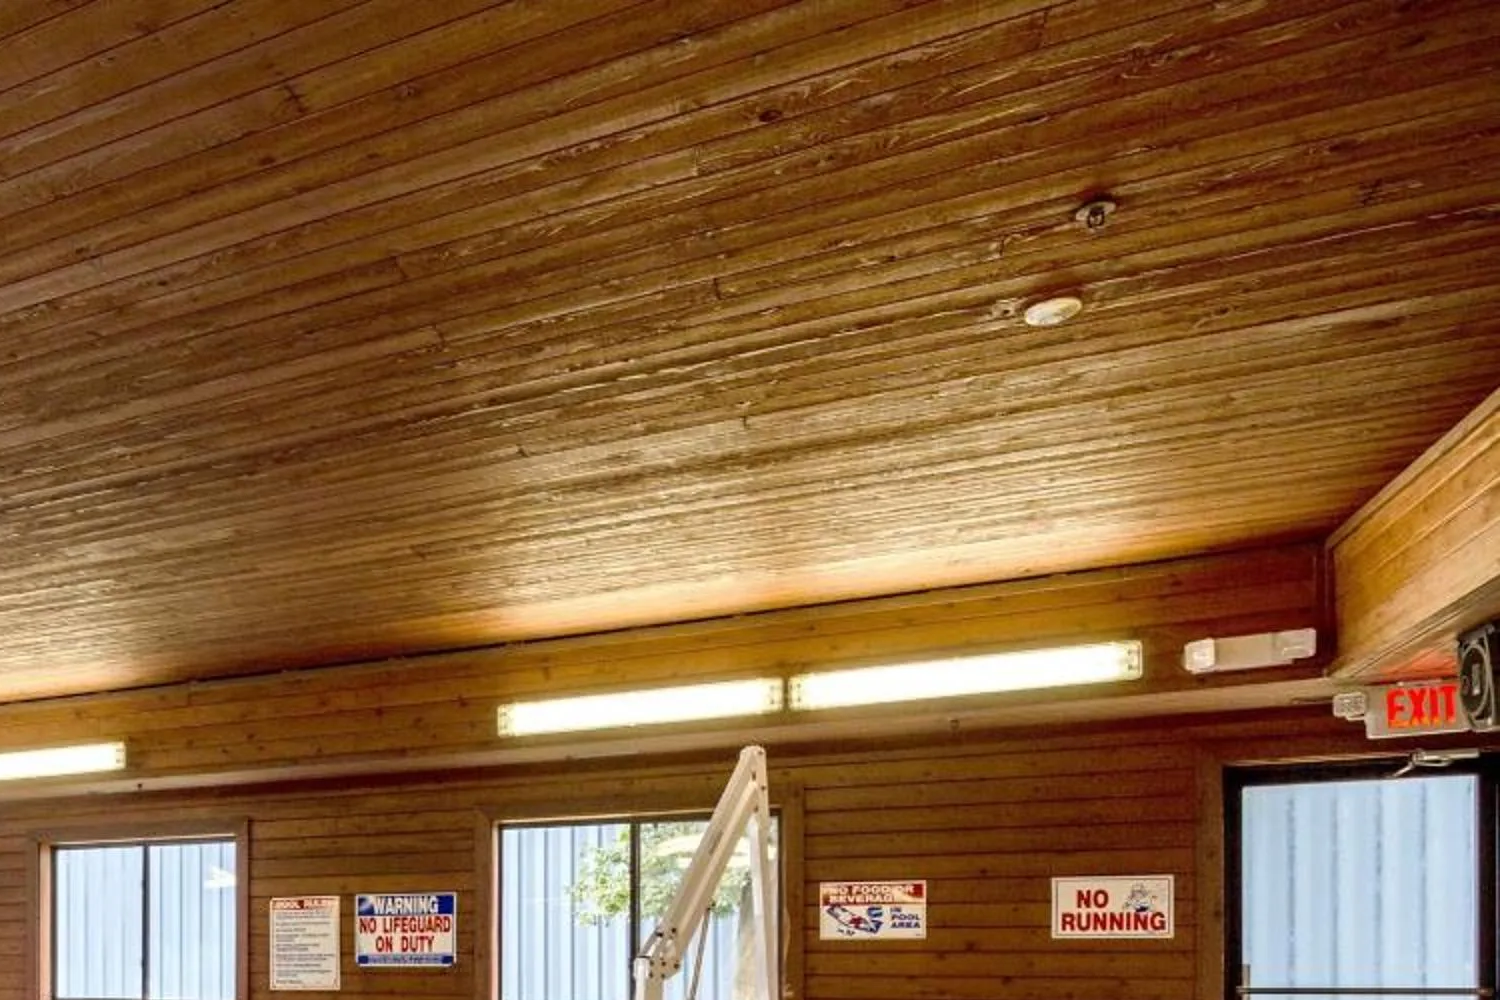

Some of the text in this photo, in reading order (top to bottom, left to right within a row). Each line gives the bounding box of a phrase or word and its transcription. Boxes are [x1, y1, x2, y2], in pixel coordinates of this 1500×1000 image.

[1387, 685, 1457, 728] EXIT
[852, 885, 890, 894] FOOD
[374, 896, 439, 914] WARNING
[829, 894, 899, 904] BEVERAG
[1077, 889, 1108, 909] NO
[359, 915, 451, 934] NO LIFEGUARD
[1061, 912, 1166, 931] RUNNING
[376, 935, 435, 952] ON DUTY
